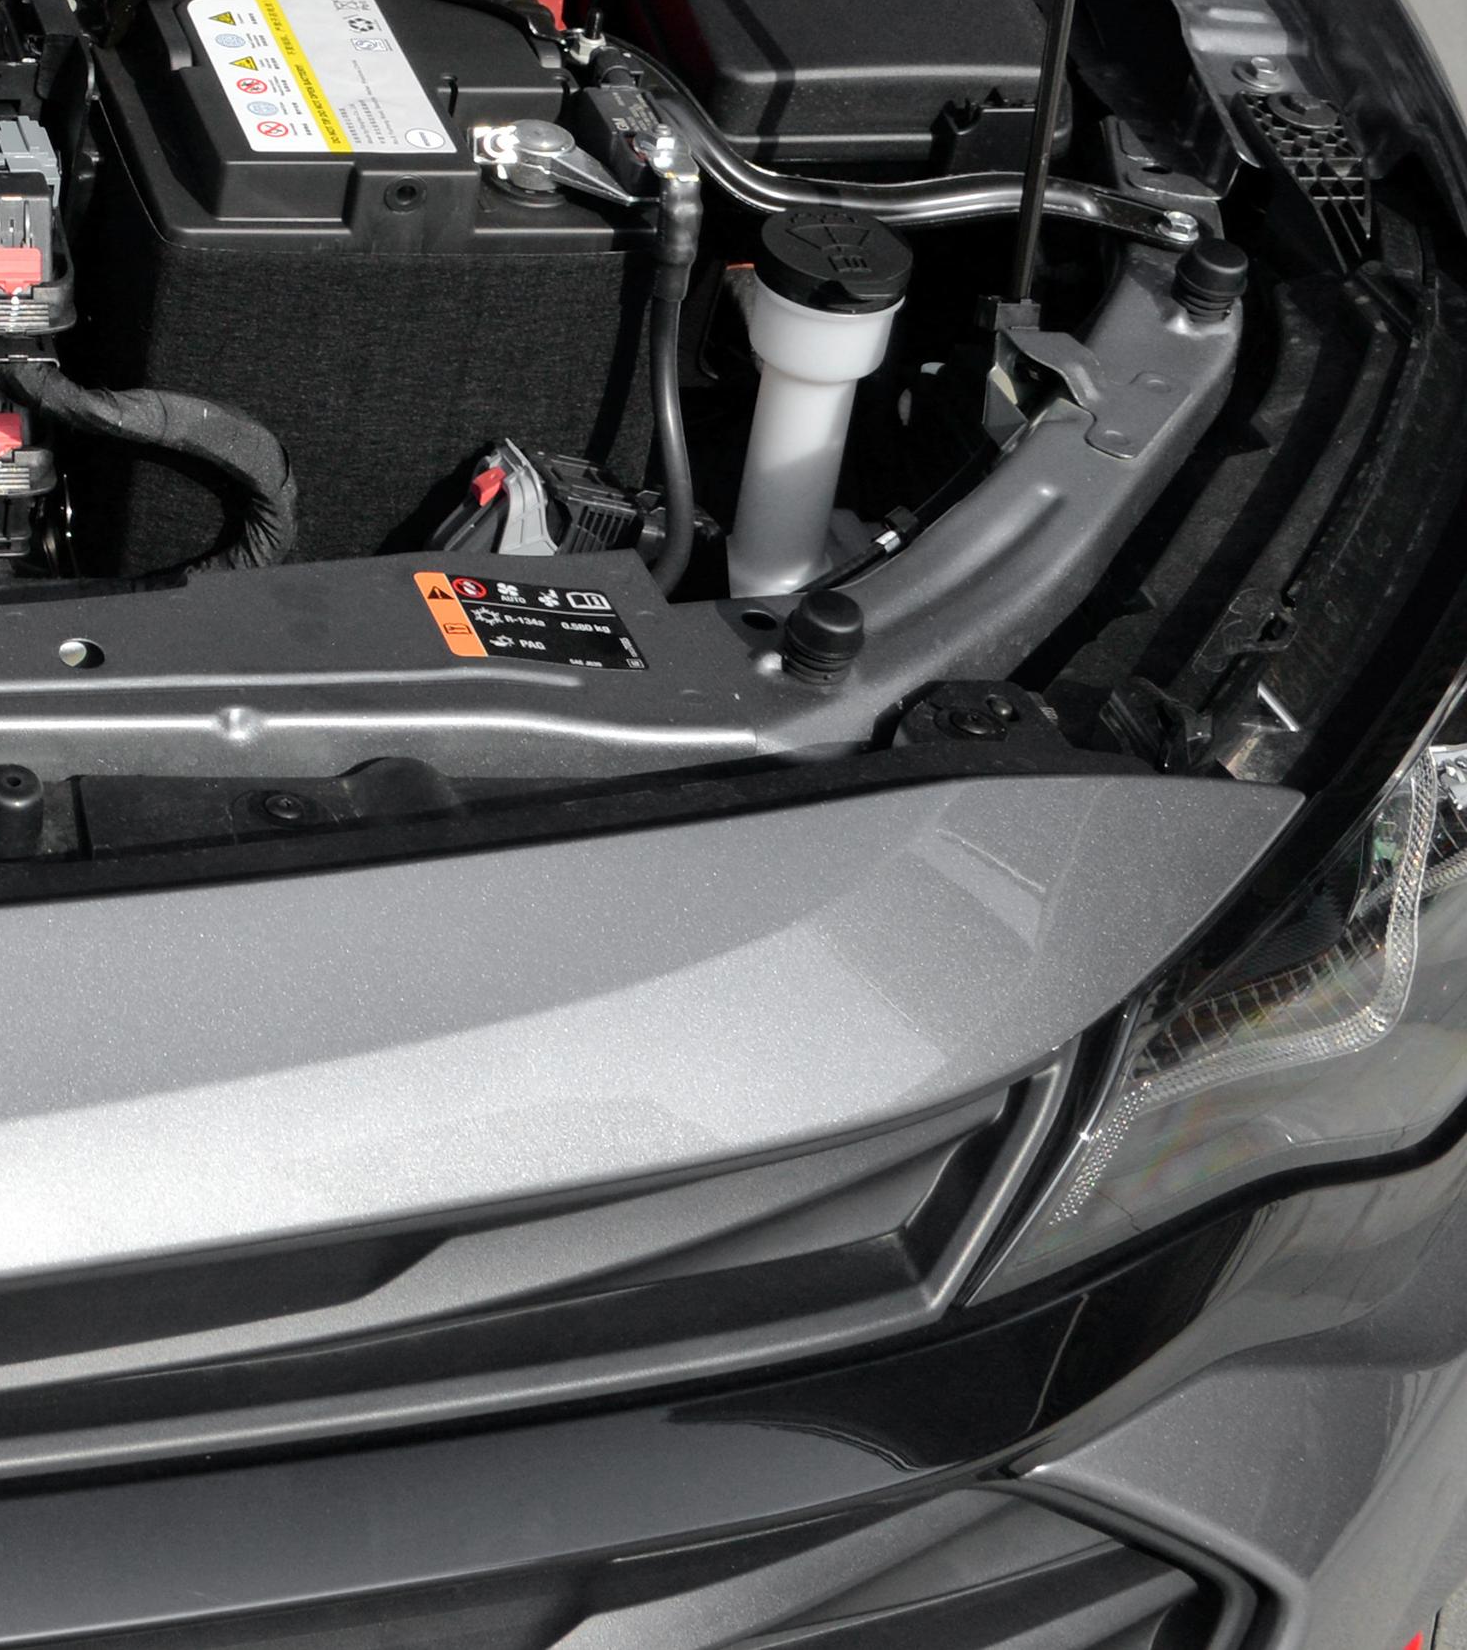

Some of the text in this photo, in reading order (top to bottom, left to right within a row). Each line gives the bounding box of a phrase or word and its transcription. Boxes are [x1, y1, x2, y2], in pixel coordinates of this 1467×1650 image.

[501, 594, 527, 605] AUTO
[504, 614, 546, 627] R-134a
[593, 623, 612, 634] kg
